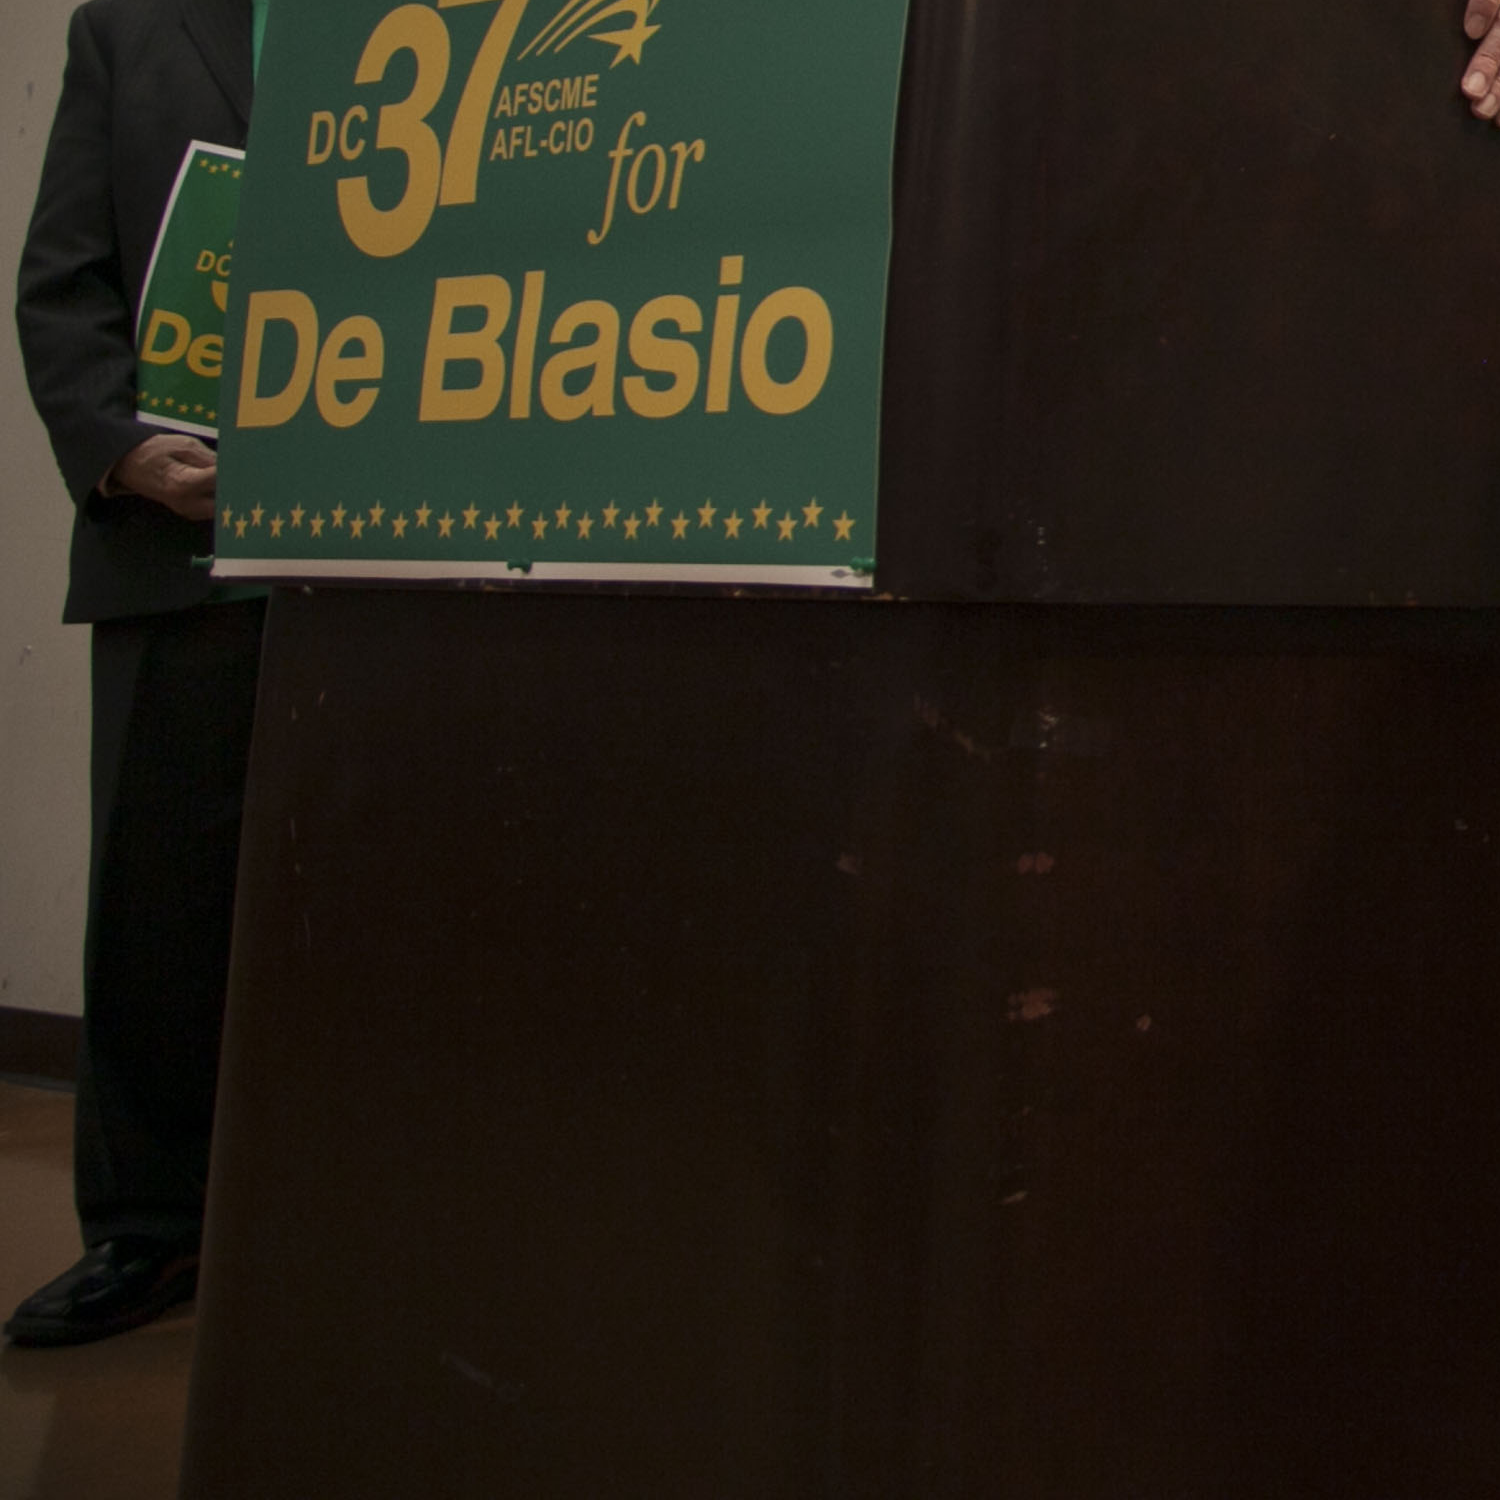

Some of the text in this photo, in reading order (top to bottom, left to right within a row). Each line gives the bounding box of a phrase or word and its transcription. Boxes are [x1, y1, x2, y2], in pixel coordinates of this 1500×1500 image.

[495, 74, 600, 119] AFSCME
[307, 104, 366, 167] DC
[490, 117, 594, 161] AFL-CIO
[587, 110, 706, 245] for
[140, 308, 224, 378] De
[236, 255, 833, 429] De Blasio
